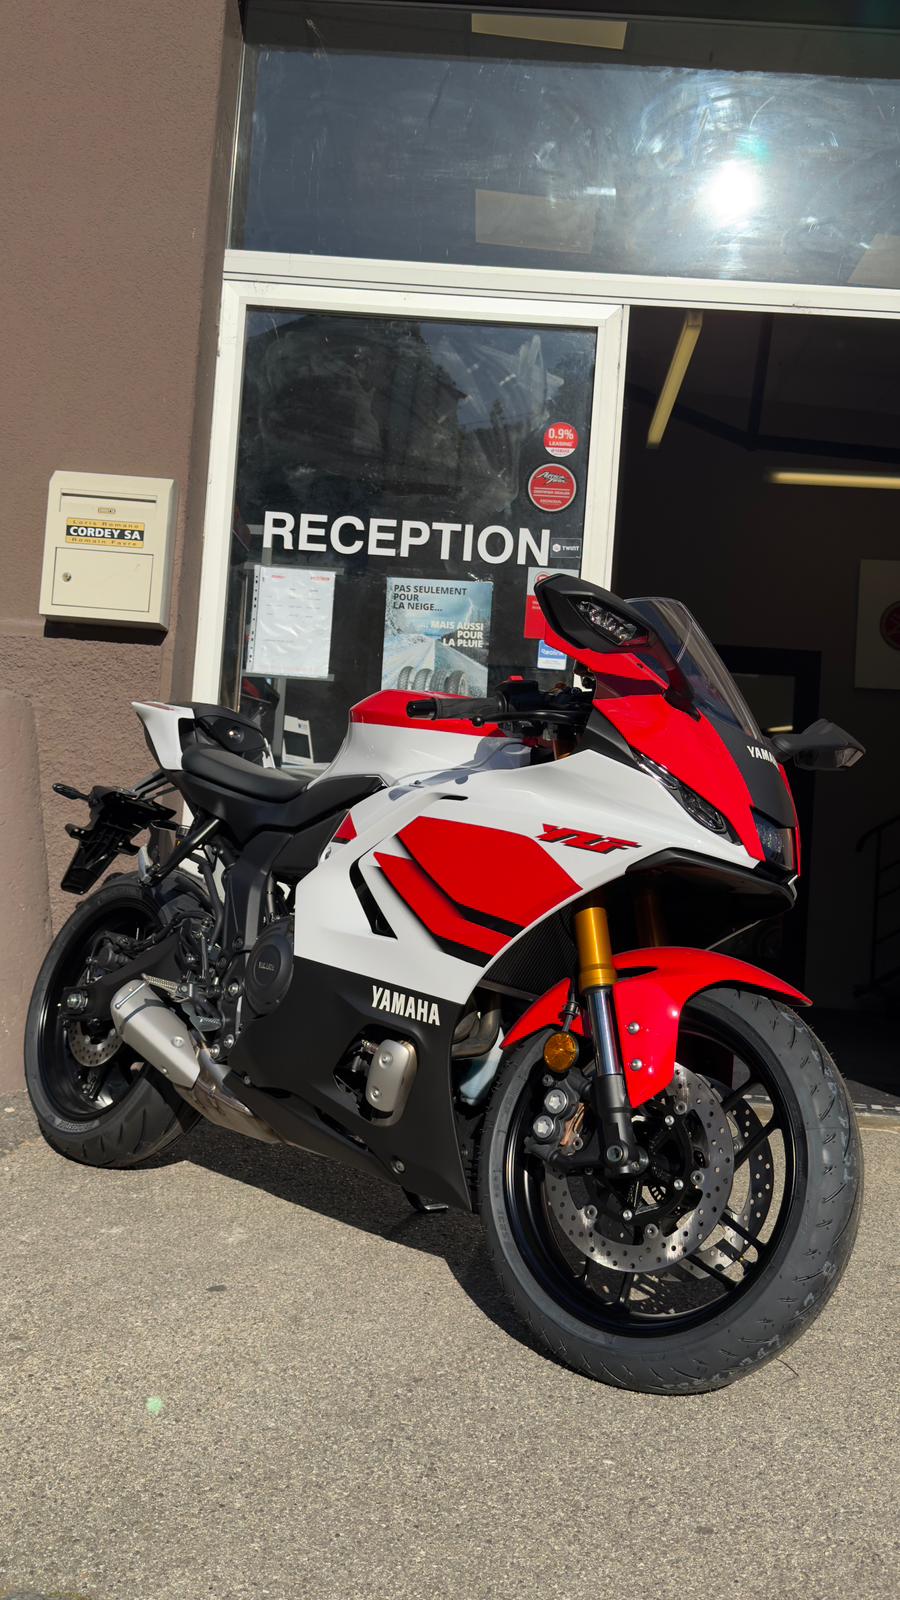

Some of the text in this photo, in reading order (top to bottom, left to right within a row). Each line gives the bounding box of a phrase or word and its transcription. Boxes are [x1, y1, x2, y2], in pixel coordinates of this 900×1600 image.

[548, 427, 574, 440] 0.9%
[69, 526, 141, 540] CORDEY SA
[262, 510, 551, 566] RECEPTION
[394, 584, 468, 596] PAS SEULEMENT
[393, 593, 419, 602] POUR
[393, 601, 405, 610] LA
[456, 622, 484, 631] AUSSI
[457, 630, 483, 639] POUR
[443, 638, 483, 648] LA PLUIE
[535, 823, 642, 855] YZF
[371, 984, 441, 1026] YAMAHA
